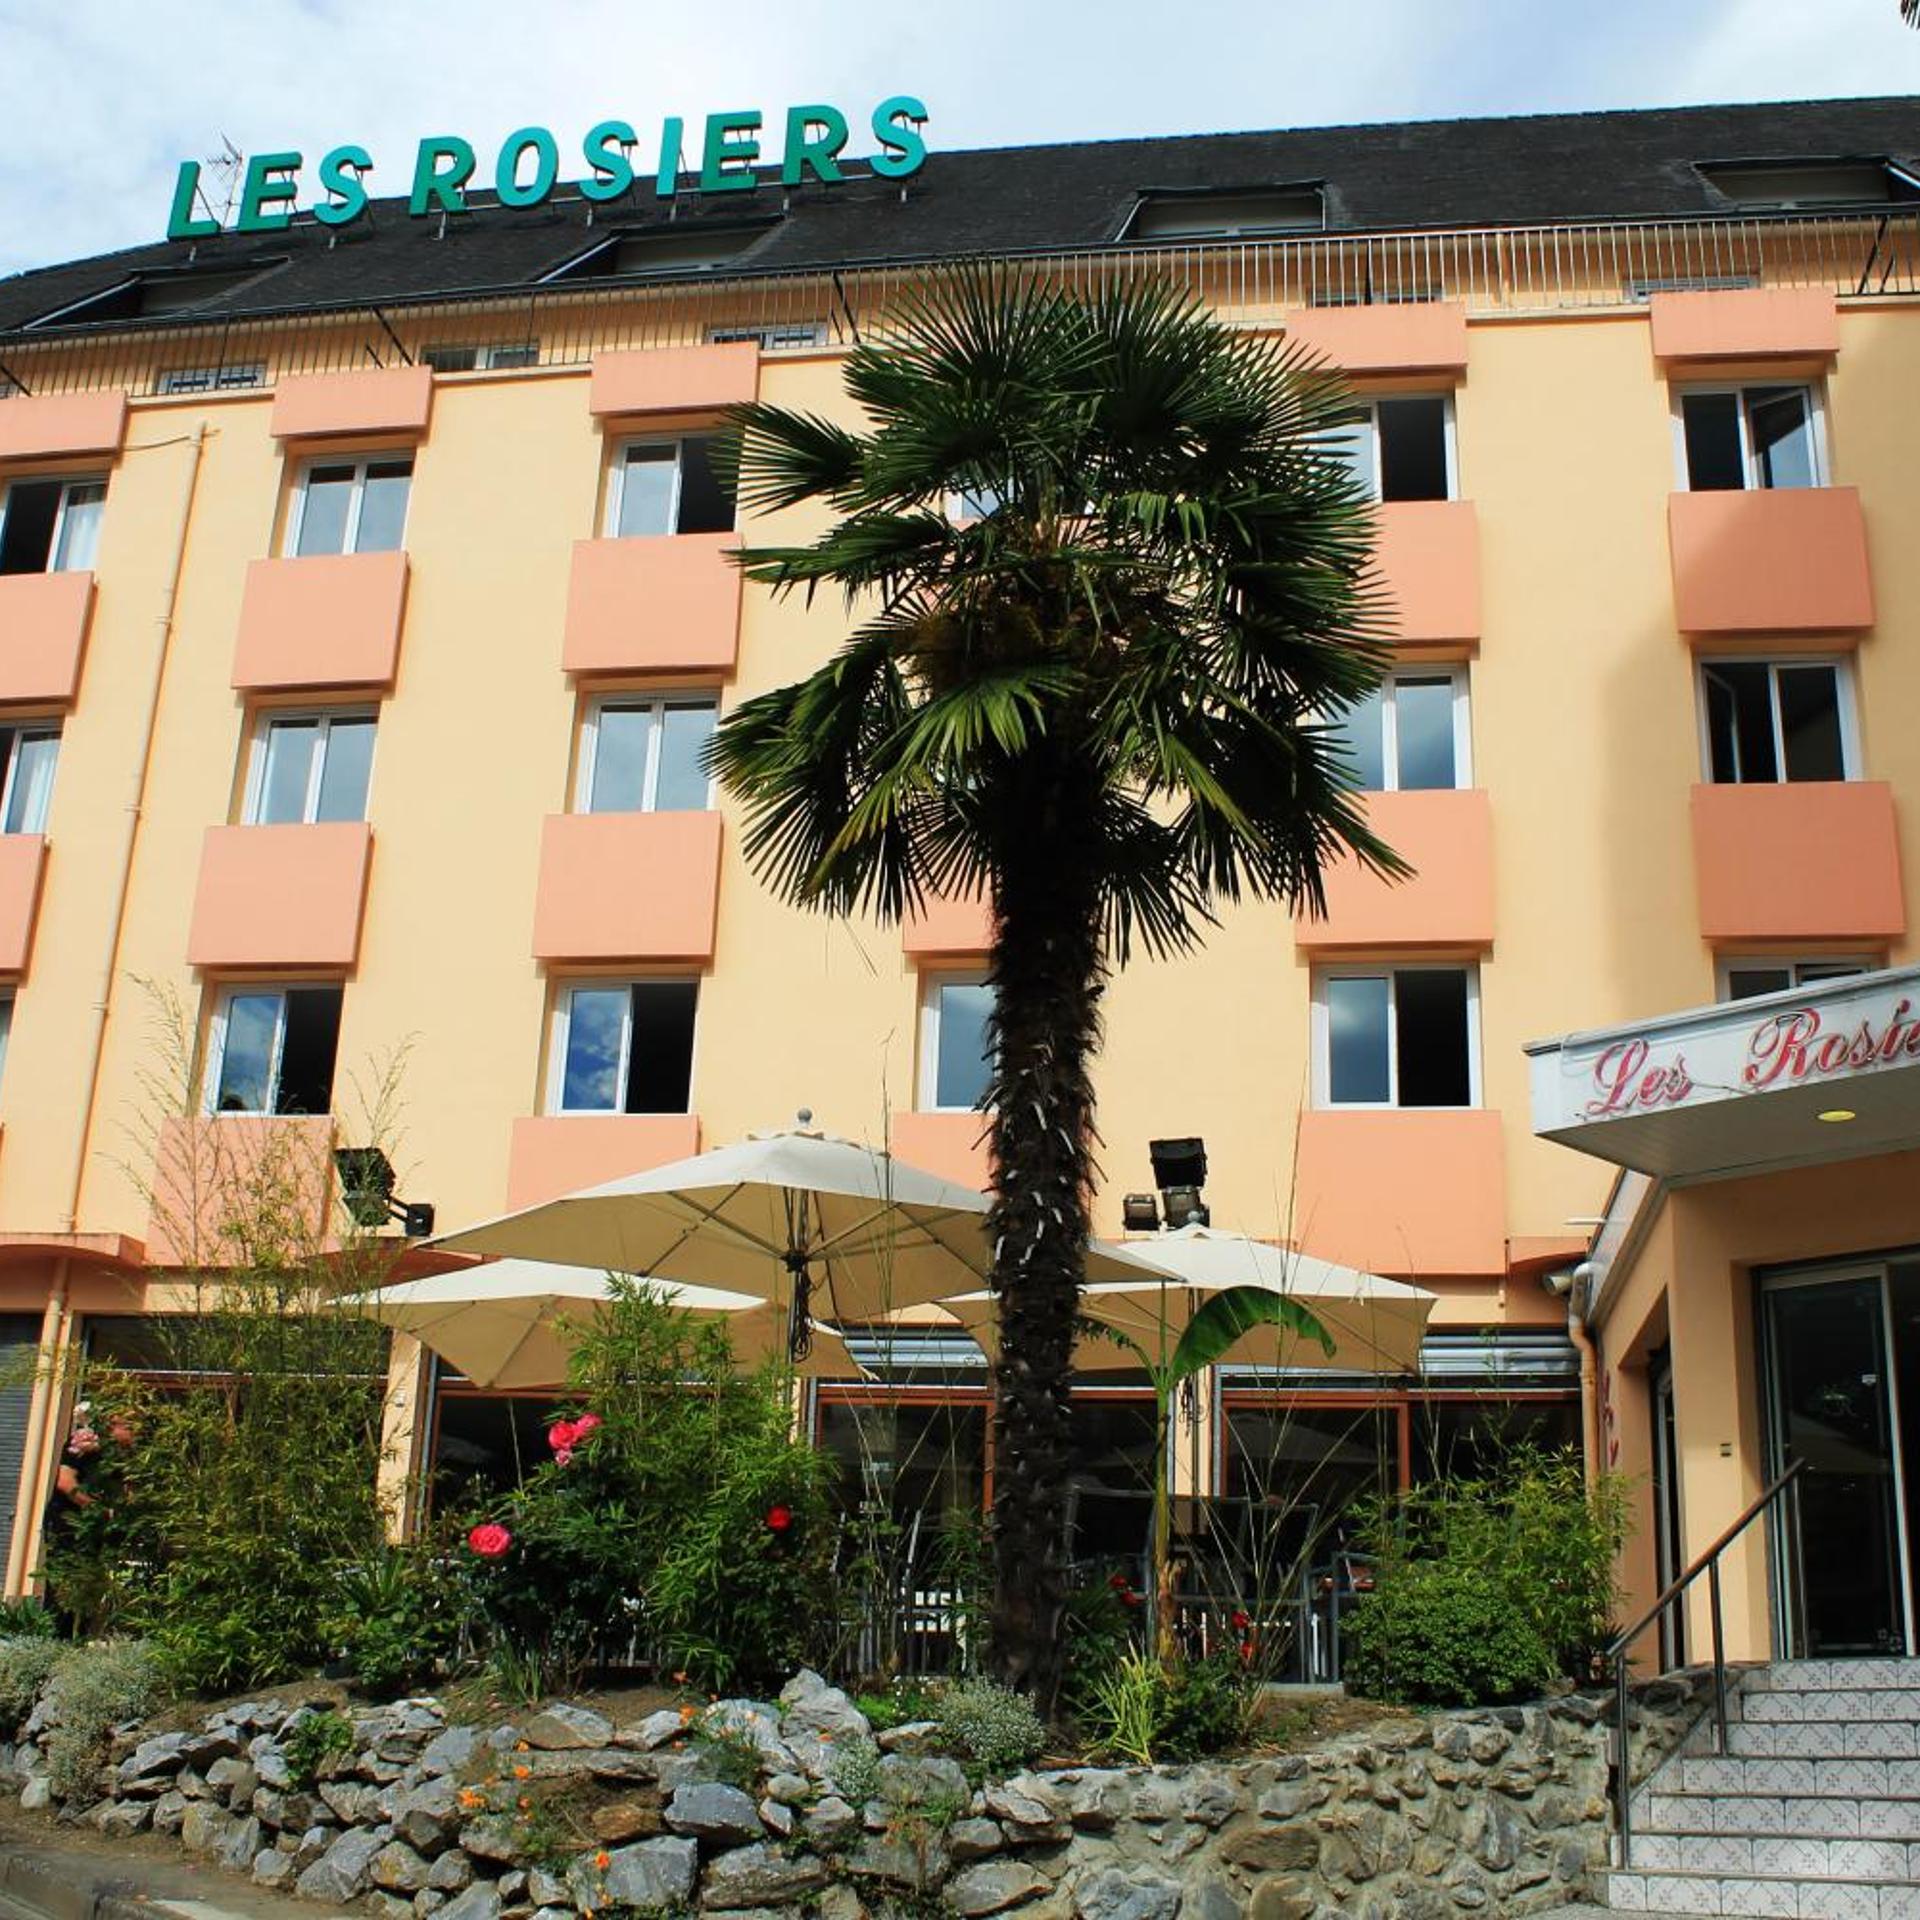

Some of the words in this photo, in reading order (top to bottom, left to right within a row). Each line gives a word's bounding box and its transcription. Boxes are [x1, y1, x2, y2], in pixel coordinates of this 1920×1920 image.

[167, 145, 373, 241] LES
[408, 95, 929, 217] ROSIERS
[1586, 1038, 1693, 1115] Les
